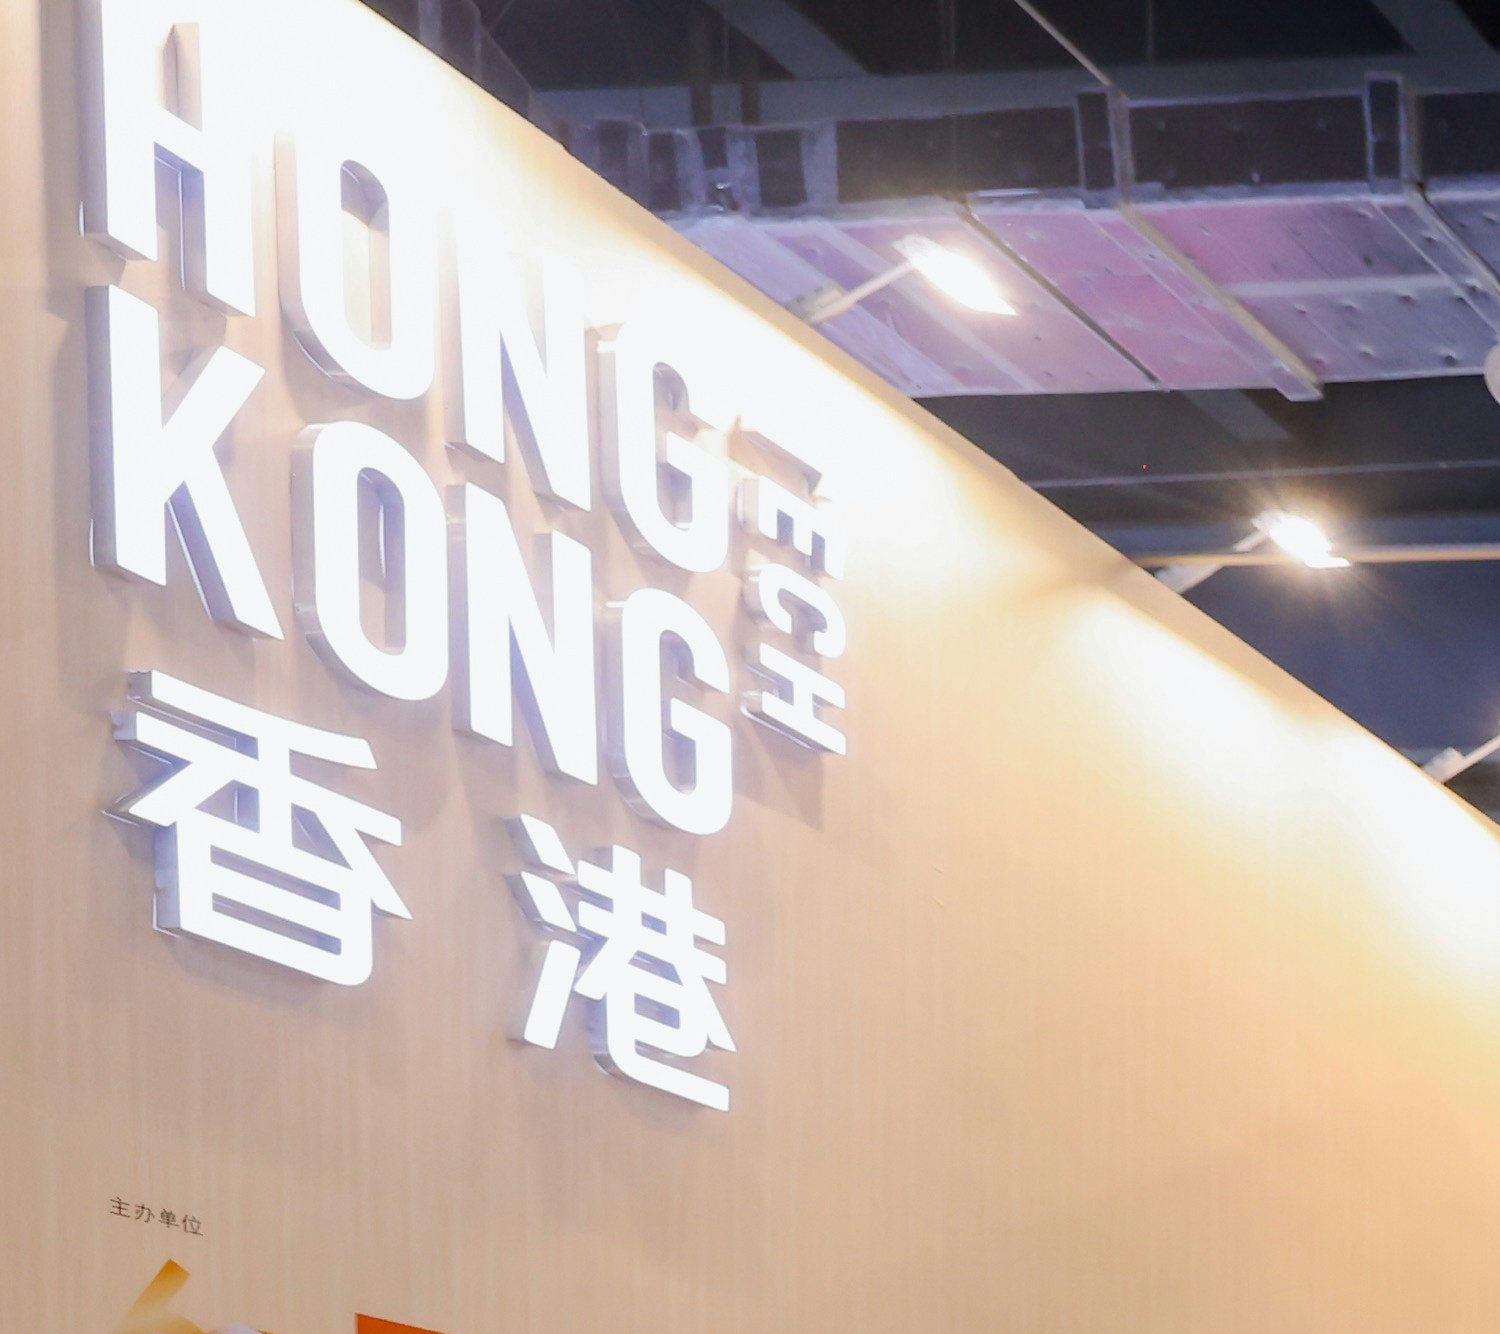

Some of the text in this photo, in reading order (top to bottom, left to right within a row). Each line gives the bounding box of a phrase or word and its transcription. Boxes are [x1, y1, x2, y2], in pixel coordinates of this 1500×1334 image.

[82, 0, 730, 572] HONG
[92, 285, 733, 834] KONG
[737, 415, 847, 754] TECH
[104, 668, 738, 1111] 香港
[109, 1196, 204, 1237] 主办单位
